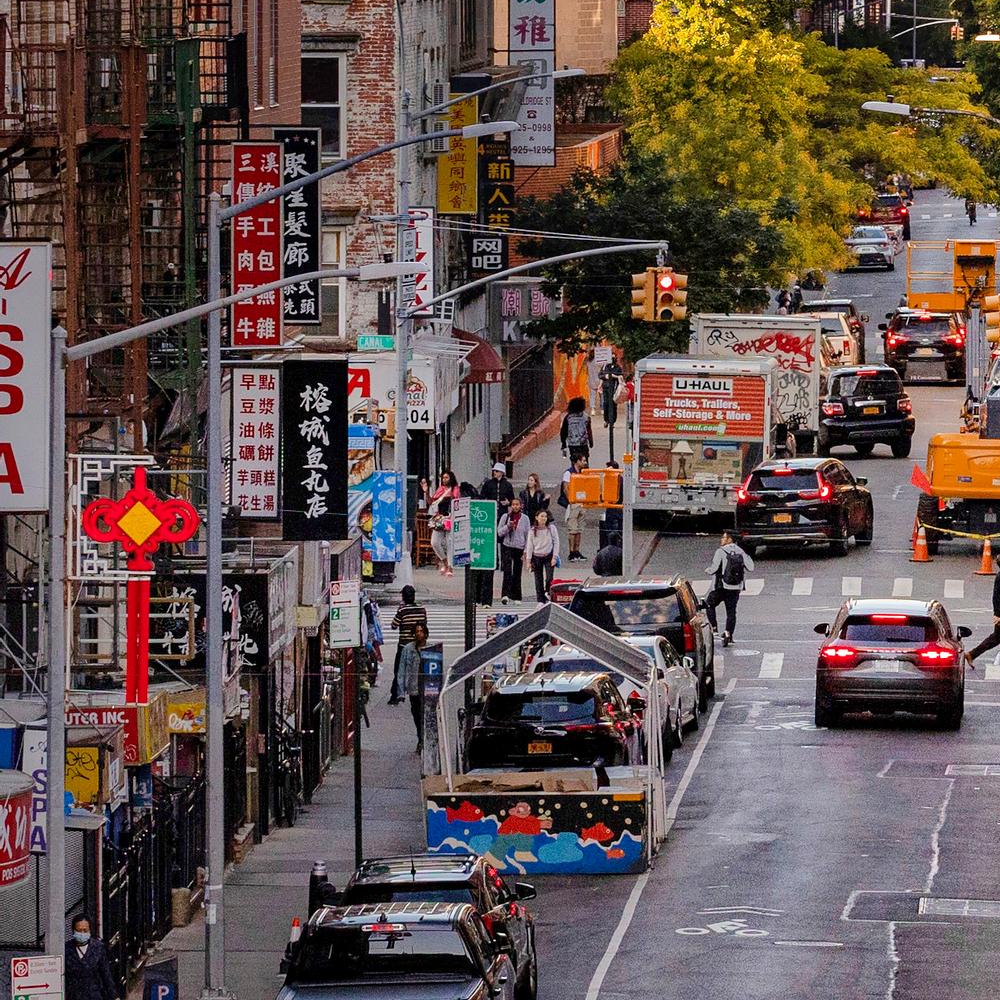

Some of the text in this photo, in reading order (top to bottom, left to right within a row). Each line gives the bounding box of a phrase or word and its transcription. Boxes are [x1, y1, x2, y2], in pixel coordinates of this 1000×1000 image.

[518, 123, 552, 132] 25-0998
[472, 239, 502, 270] 网吧
[676, 380, 730, 391] U-HAUL
[388, 389, 425, 400] Cnal
[665, 398, 740, 410] Trucks, Trailers,
[653, 409, 752, 420] Self-Storage & More
[103, 711, 129, 724] INC.
